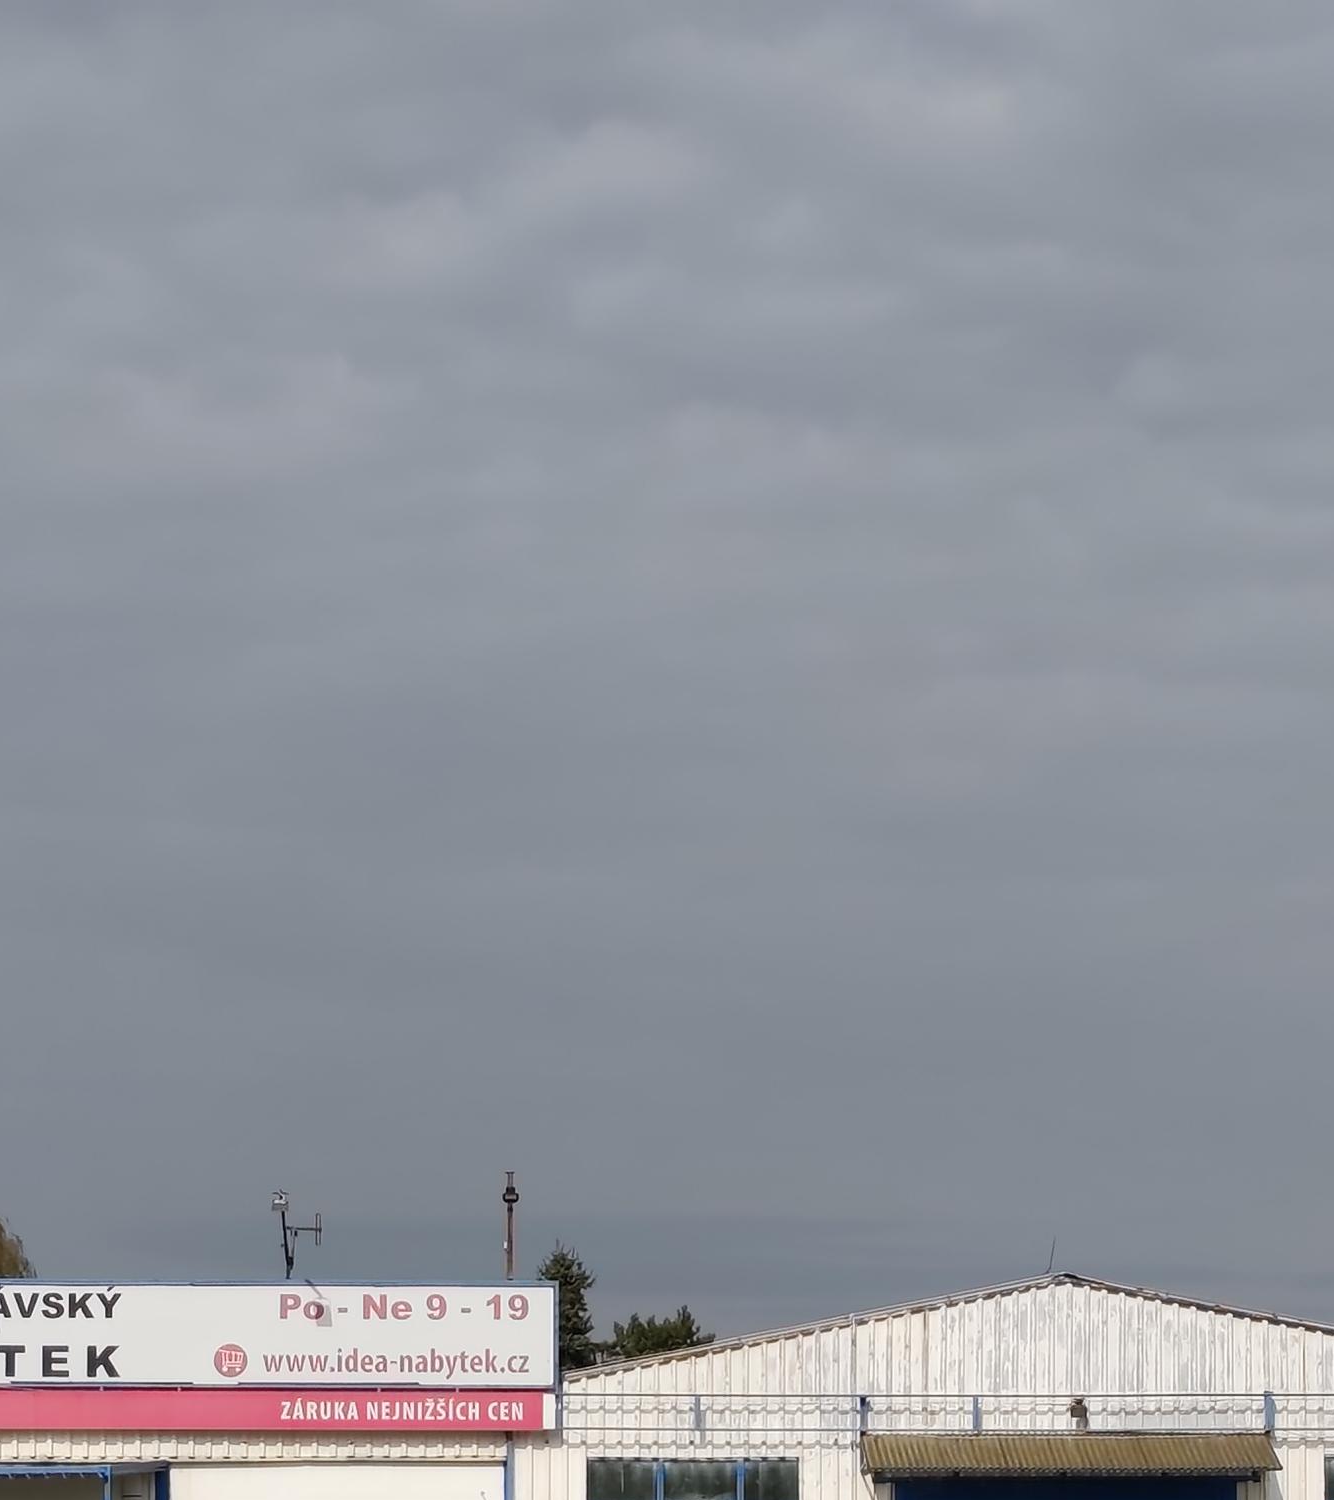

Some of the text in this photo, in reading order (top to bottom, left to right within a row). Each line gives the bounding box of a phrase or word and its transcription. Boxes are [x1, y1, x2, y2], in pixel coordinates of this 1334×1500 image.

[279, 1293, 324, 1320] Po
[362, 1293, 413, 1320] Ne
[426, 1294, 448, 1320] 9
[485, 1294, 529, 1321] 19
[263, 1348, 530, 1379] www.idea-nabytek.cz
[281, 1398, 524, 1421] ZÁRUKA NEJNIŽŠÍCH CEN
